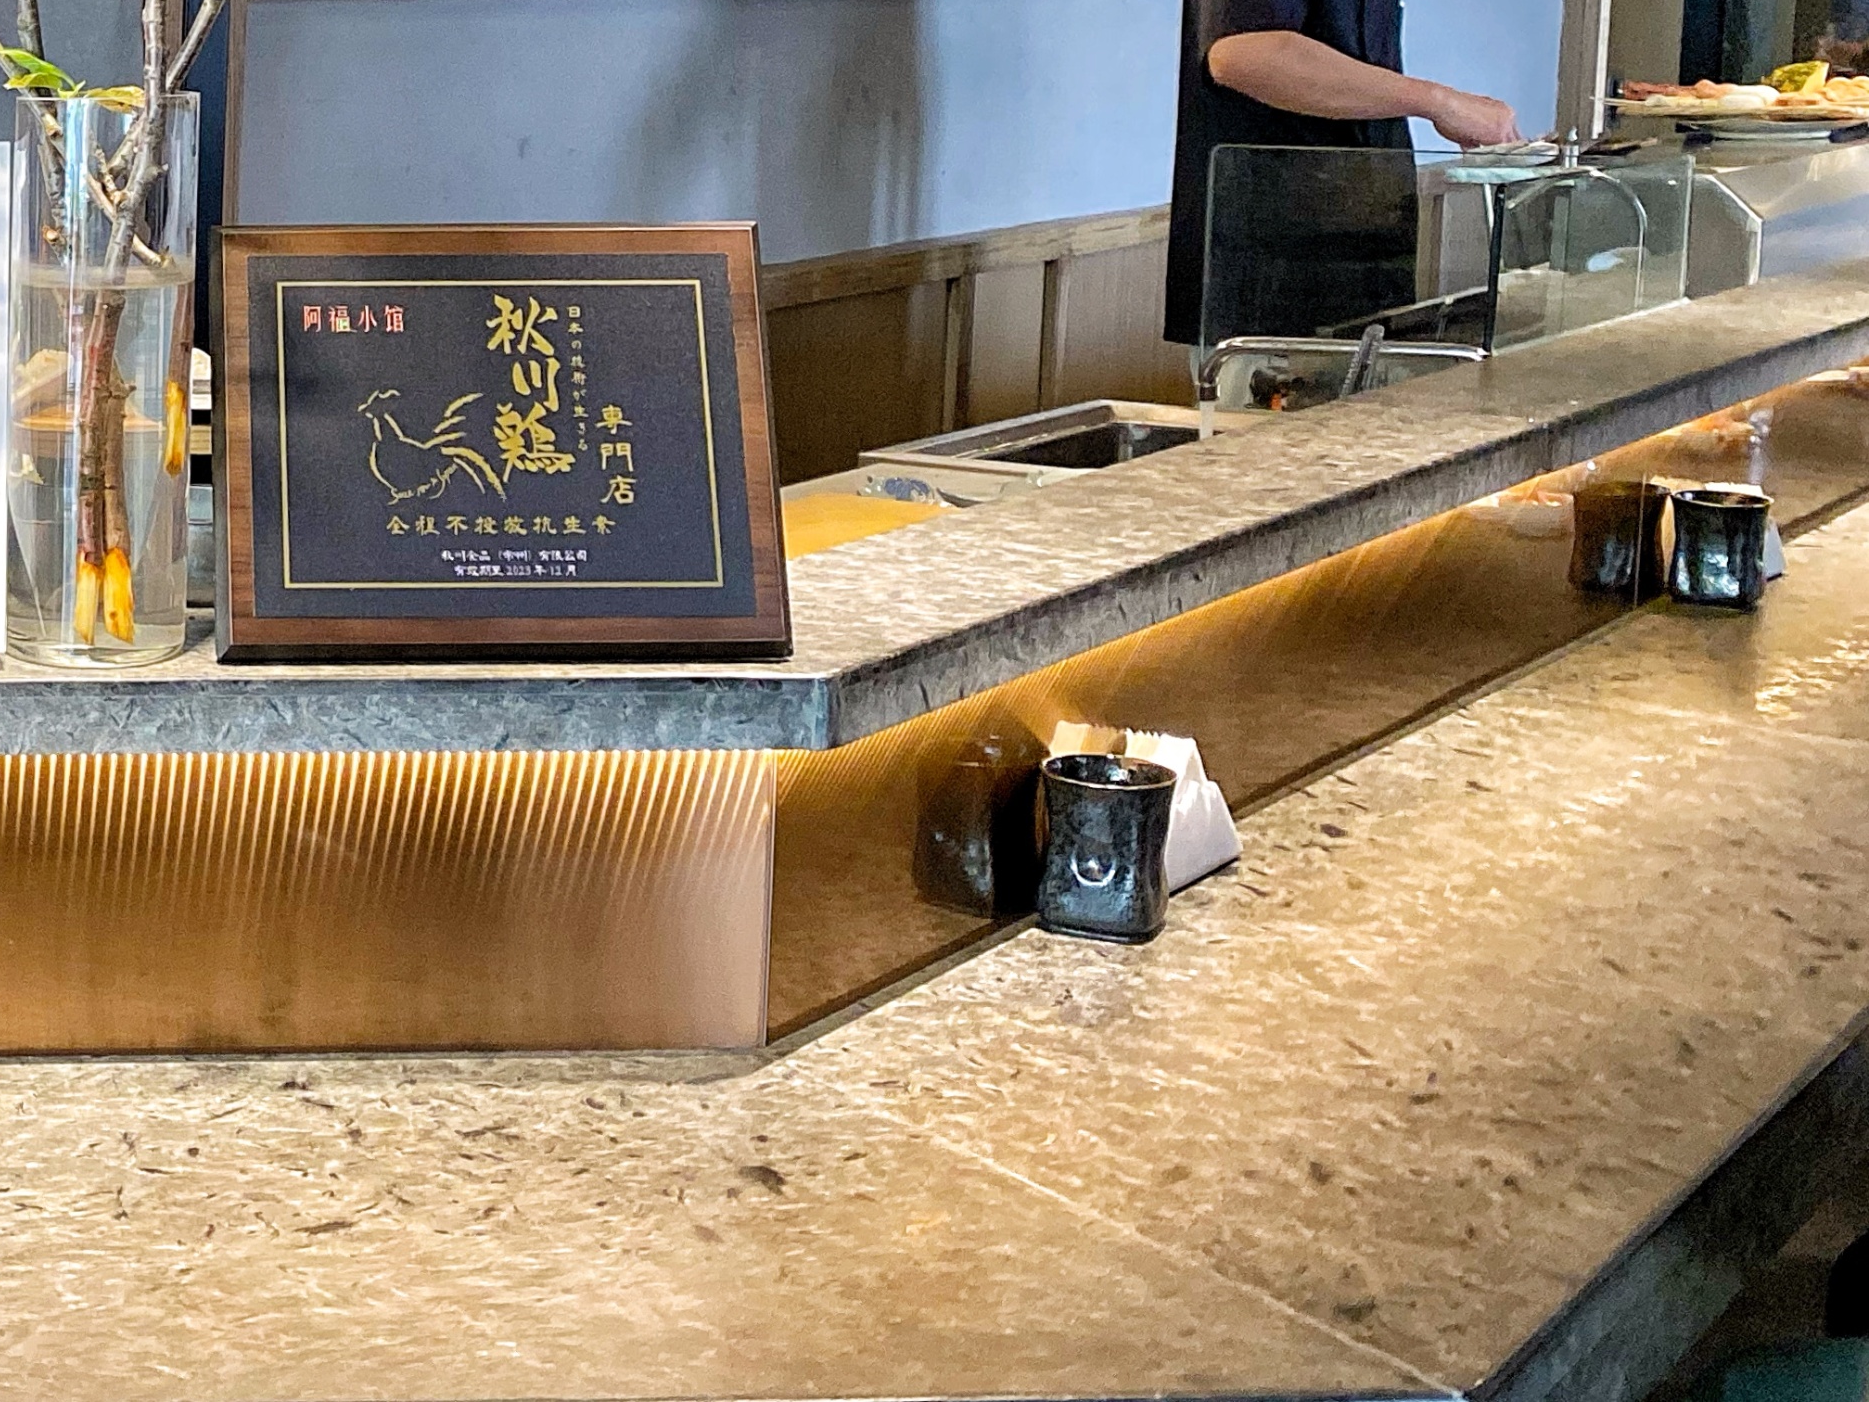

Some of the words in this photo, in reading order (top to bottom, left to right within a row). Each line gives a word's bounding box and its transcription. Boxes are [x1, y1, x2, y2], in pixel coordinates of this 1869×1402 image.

[303, 304, 405, 333] 阿福小馆
[386, 515, 616, 536] 全程不投放抗生素
